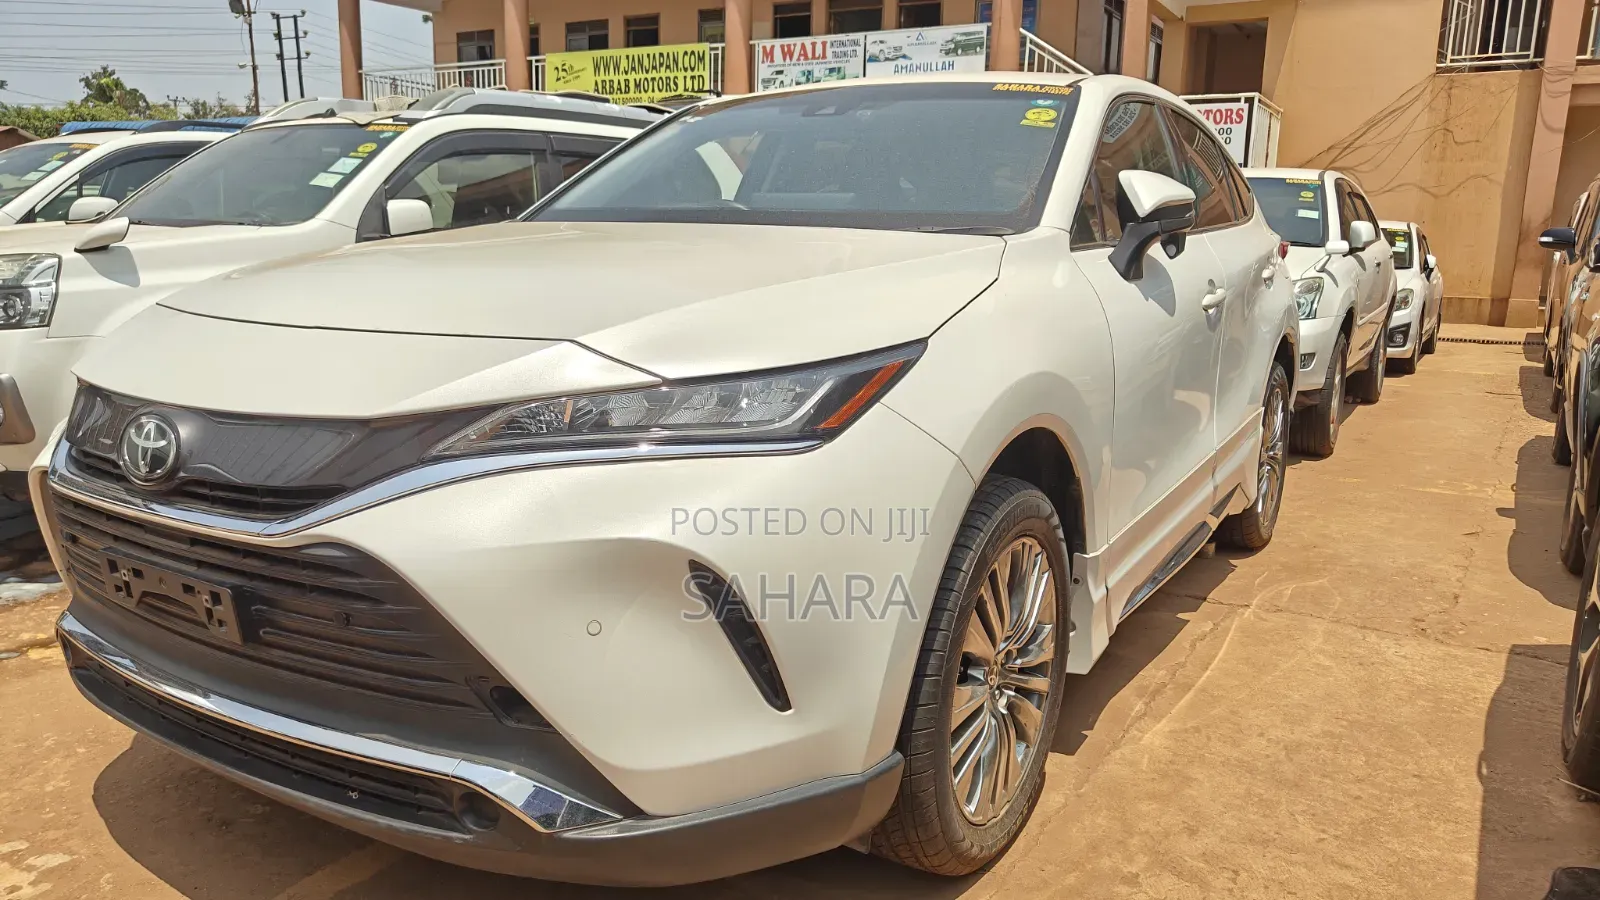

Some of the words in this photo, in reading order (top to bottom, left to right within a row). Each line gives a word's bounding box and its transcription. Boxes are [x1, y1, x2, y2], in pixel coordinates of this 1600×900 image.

[761, 44, 775, 64] M
[780, 41, 828, 62] WALI
[830, 39, 861, 49] INTERNATIONAL
[832, 50, 849, 59] TRADING
[592, 50, 706, 77] WWW.JANJAPAN.COM
[893, 60, 955, 75] AMANULLAH
[593, 78, 630, 95] ARBAB
[634, 75, 679, 93] MOTORS
[683, 74, 705, 92] LTD
[1197, 108, 1244, 125] TORS
